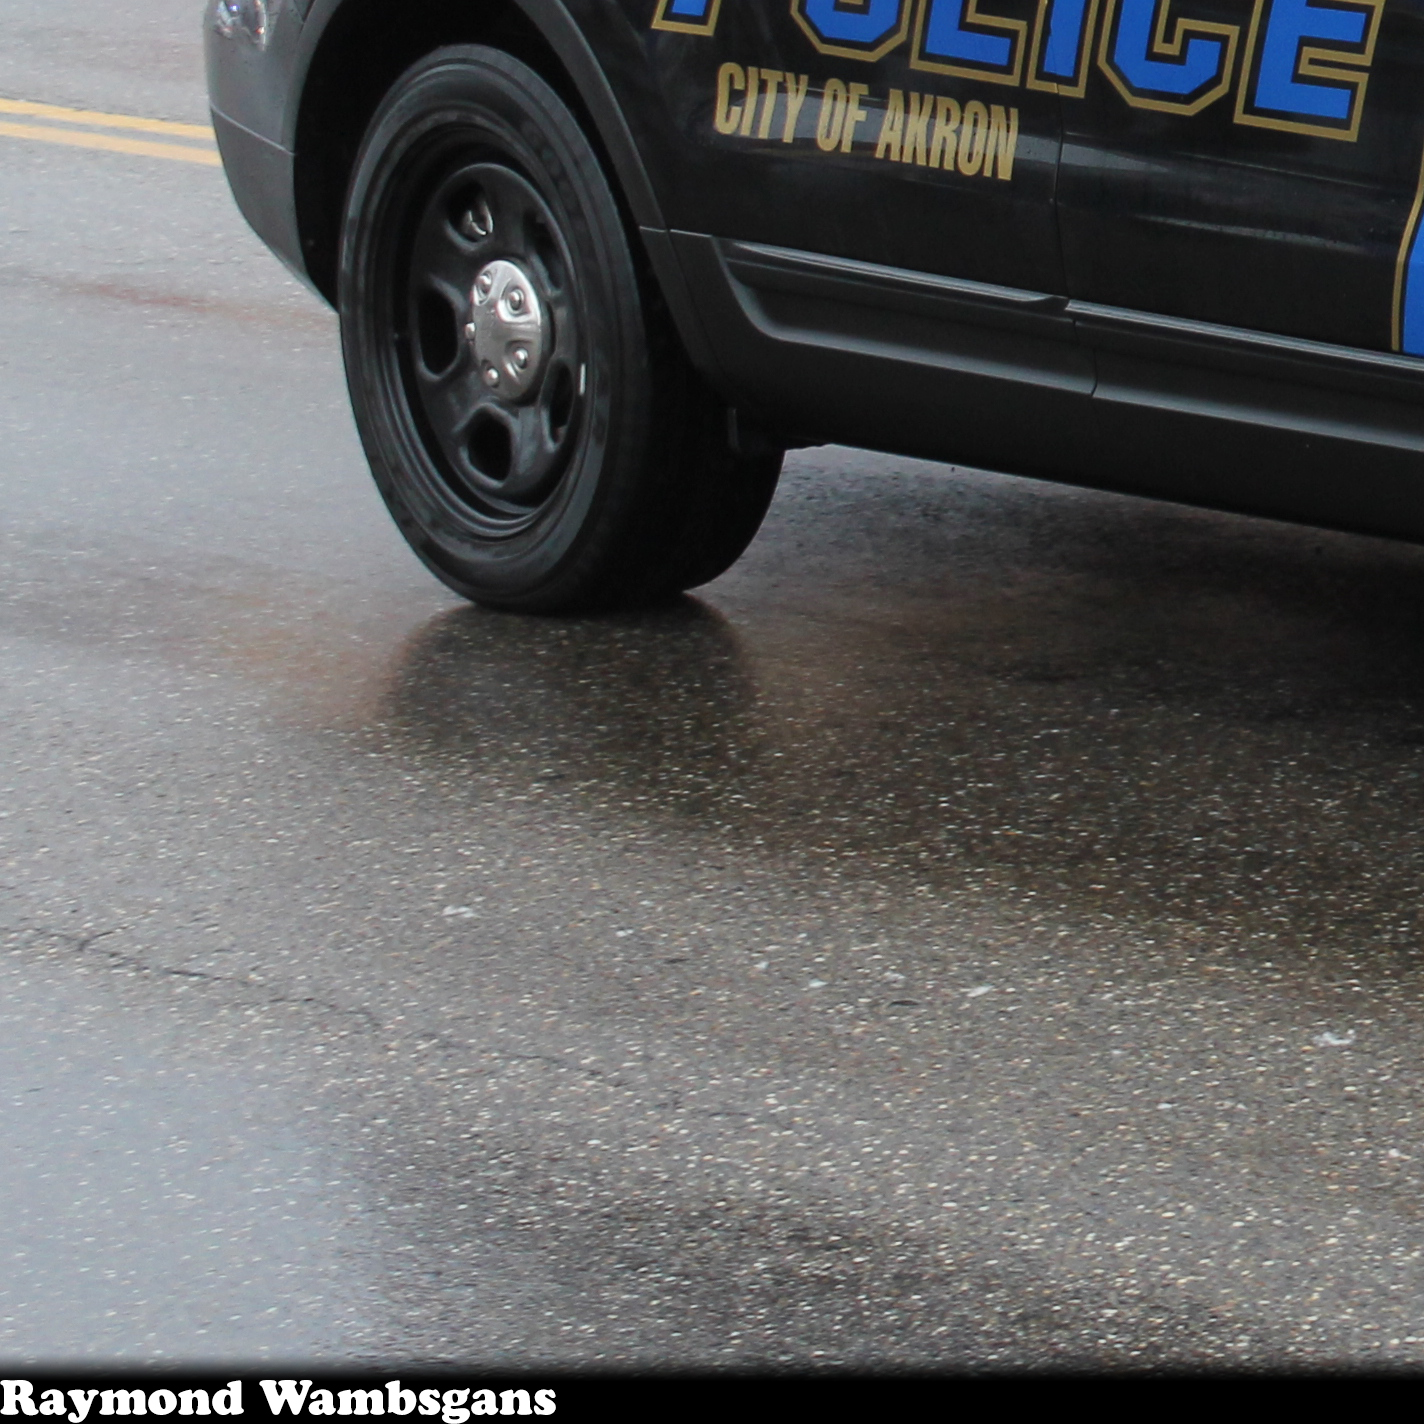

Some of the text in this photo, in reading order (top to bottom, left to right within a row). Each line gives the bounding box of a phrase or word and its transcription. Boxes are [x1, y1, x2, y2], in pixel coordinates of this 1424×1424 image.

[713, 62, 1019, 181] CITY OF AKRON
